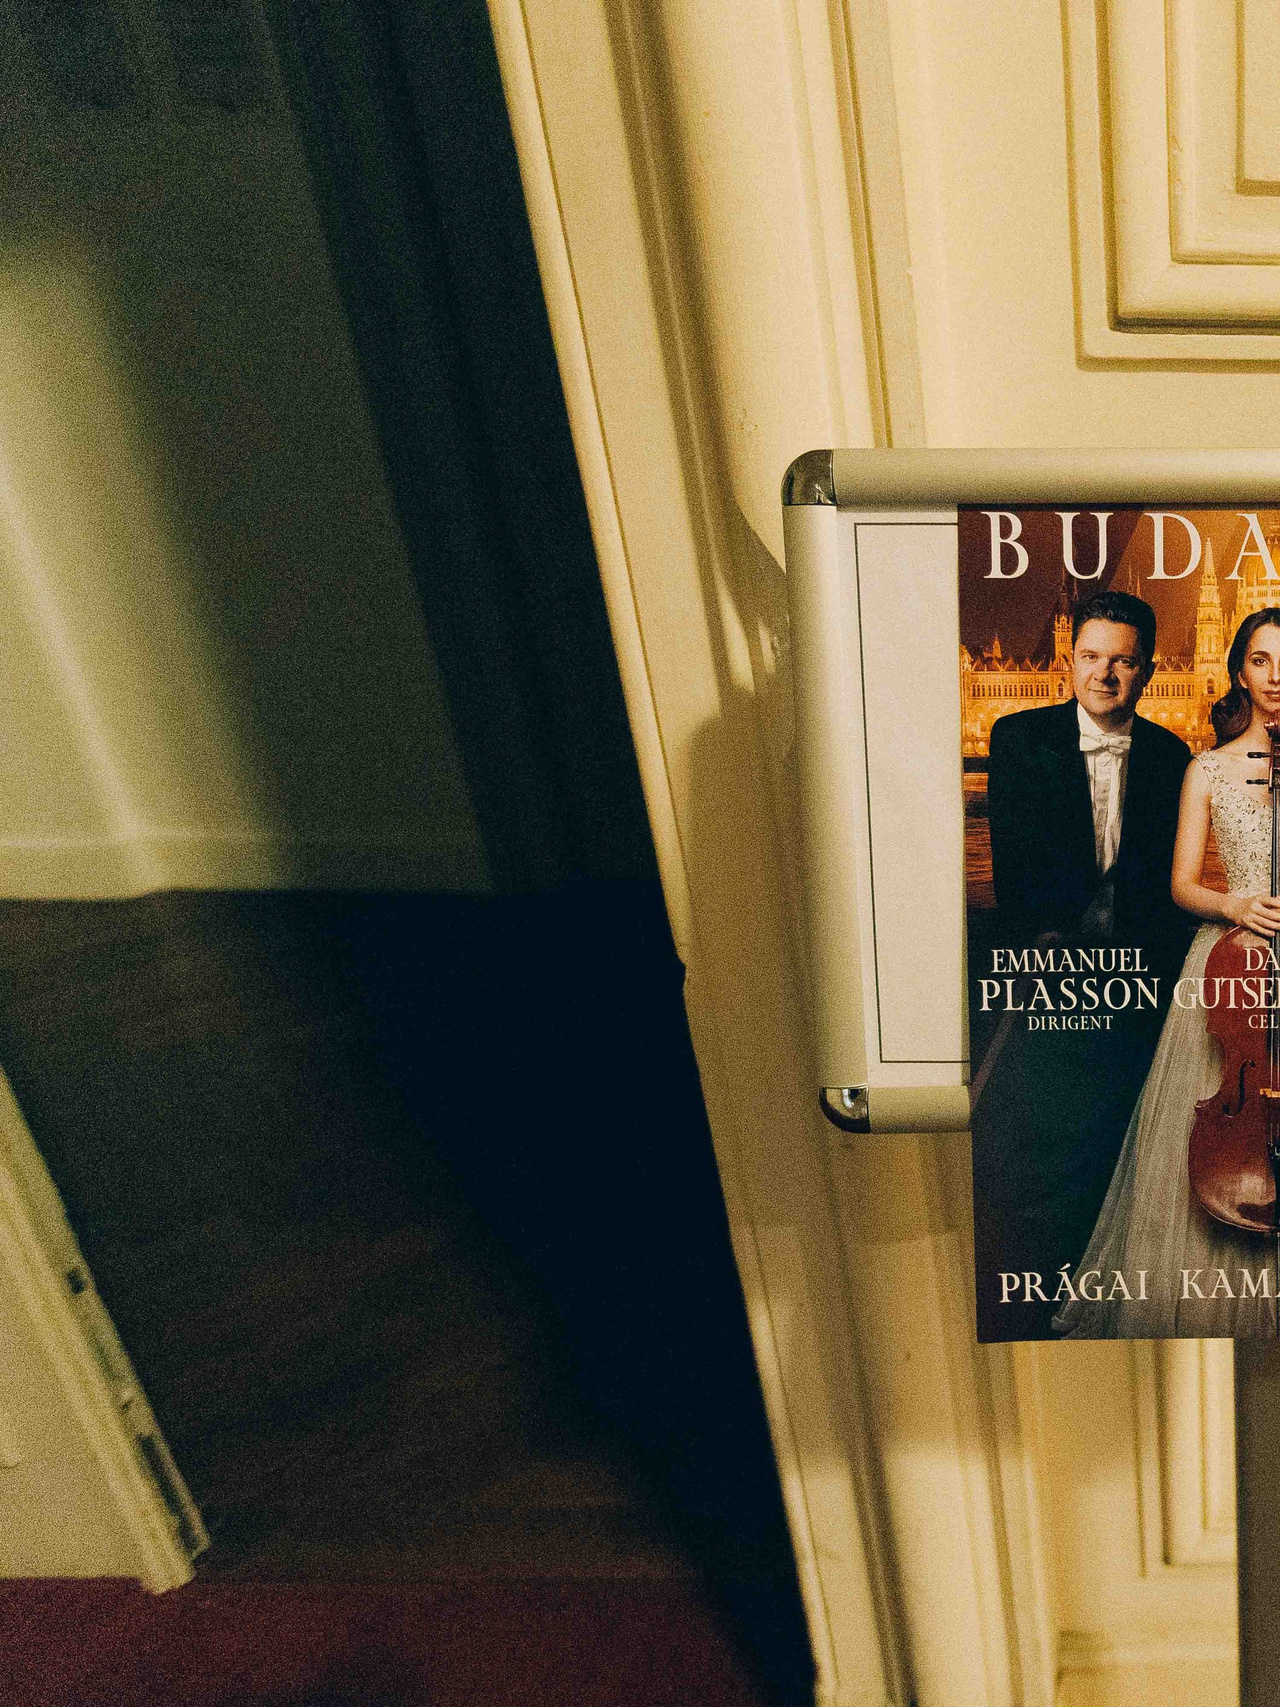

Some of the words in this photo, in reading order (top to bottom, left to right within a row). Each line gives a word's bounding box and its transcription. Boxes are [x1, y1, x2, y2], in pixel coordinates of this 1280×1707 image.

[991, 948, 1149, 973] EMMANUEL
[977, 976, 1161, 1012] PLASSON
[1027, 1015, 1114, 1031] DIRIGENT
[998, 1262, 1150, 1303] PRÁGAI
